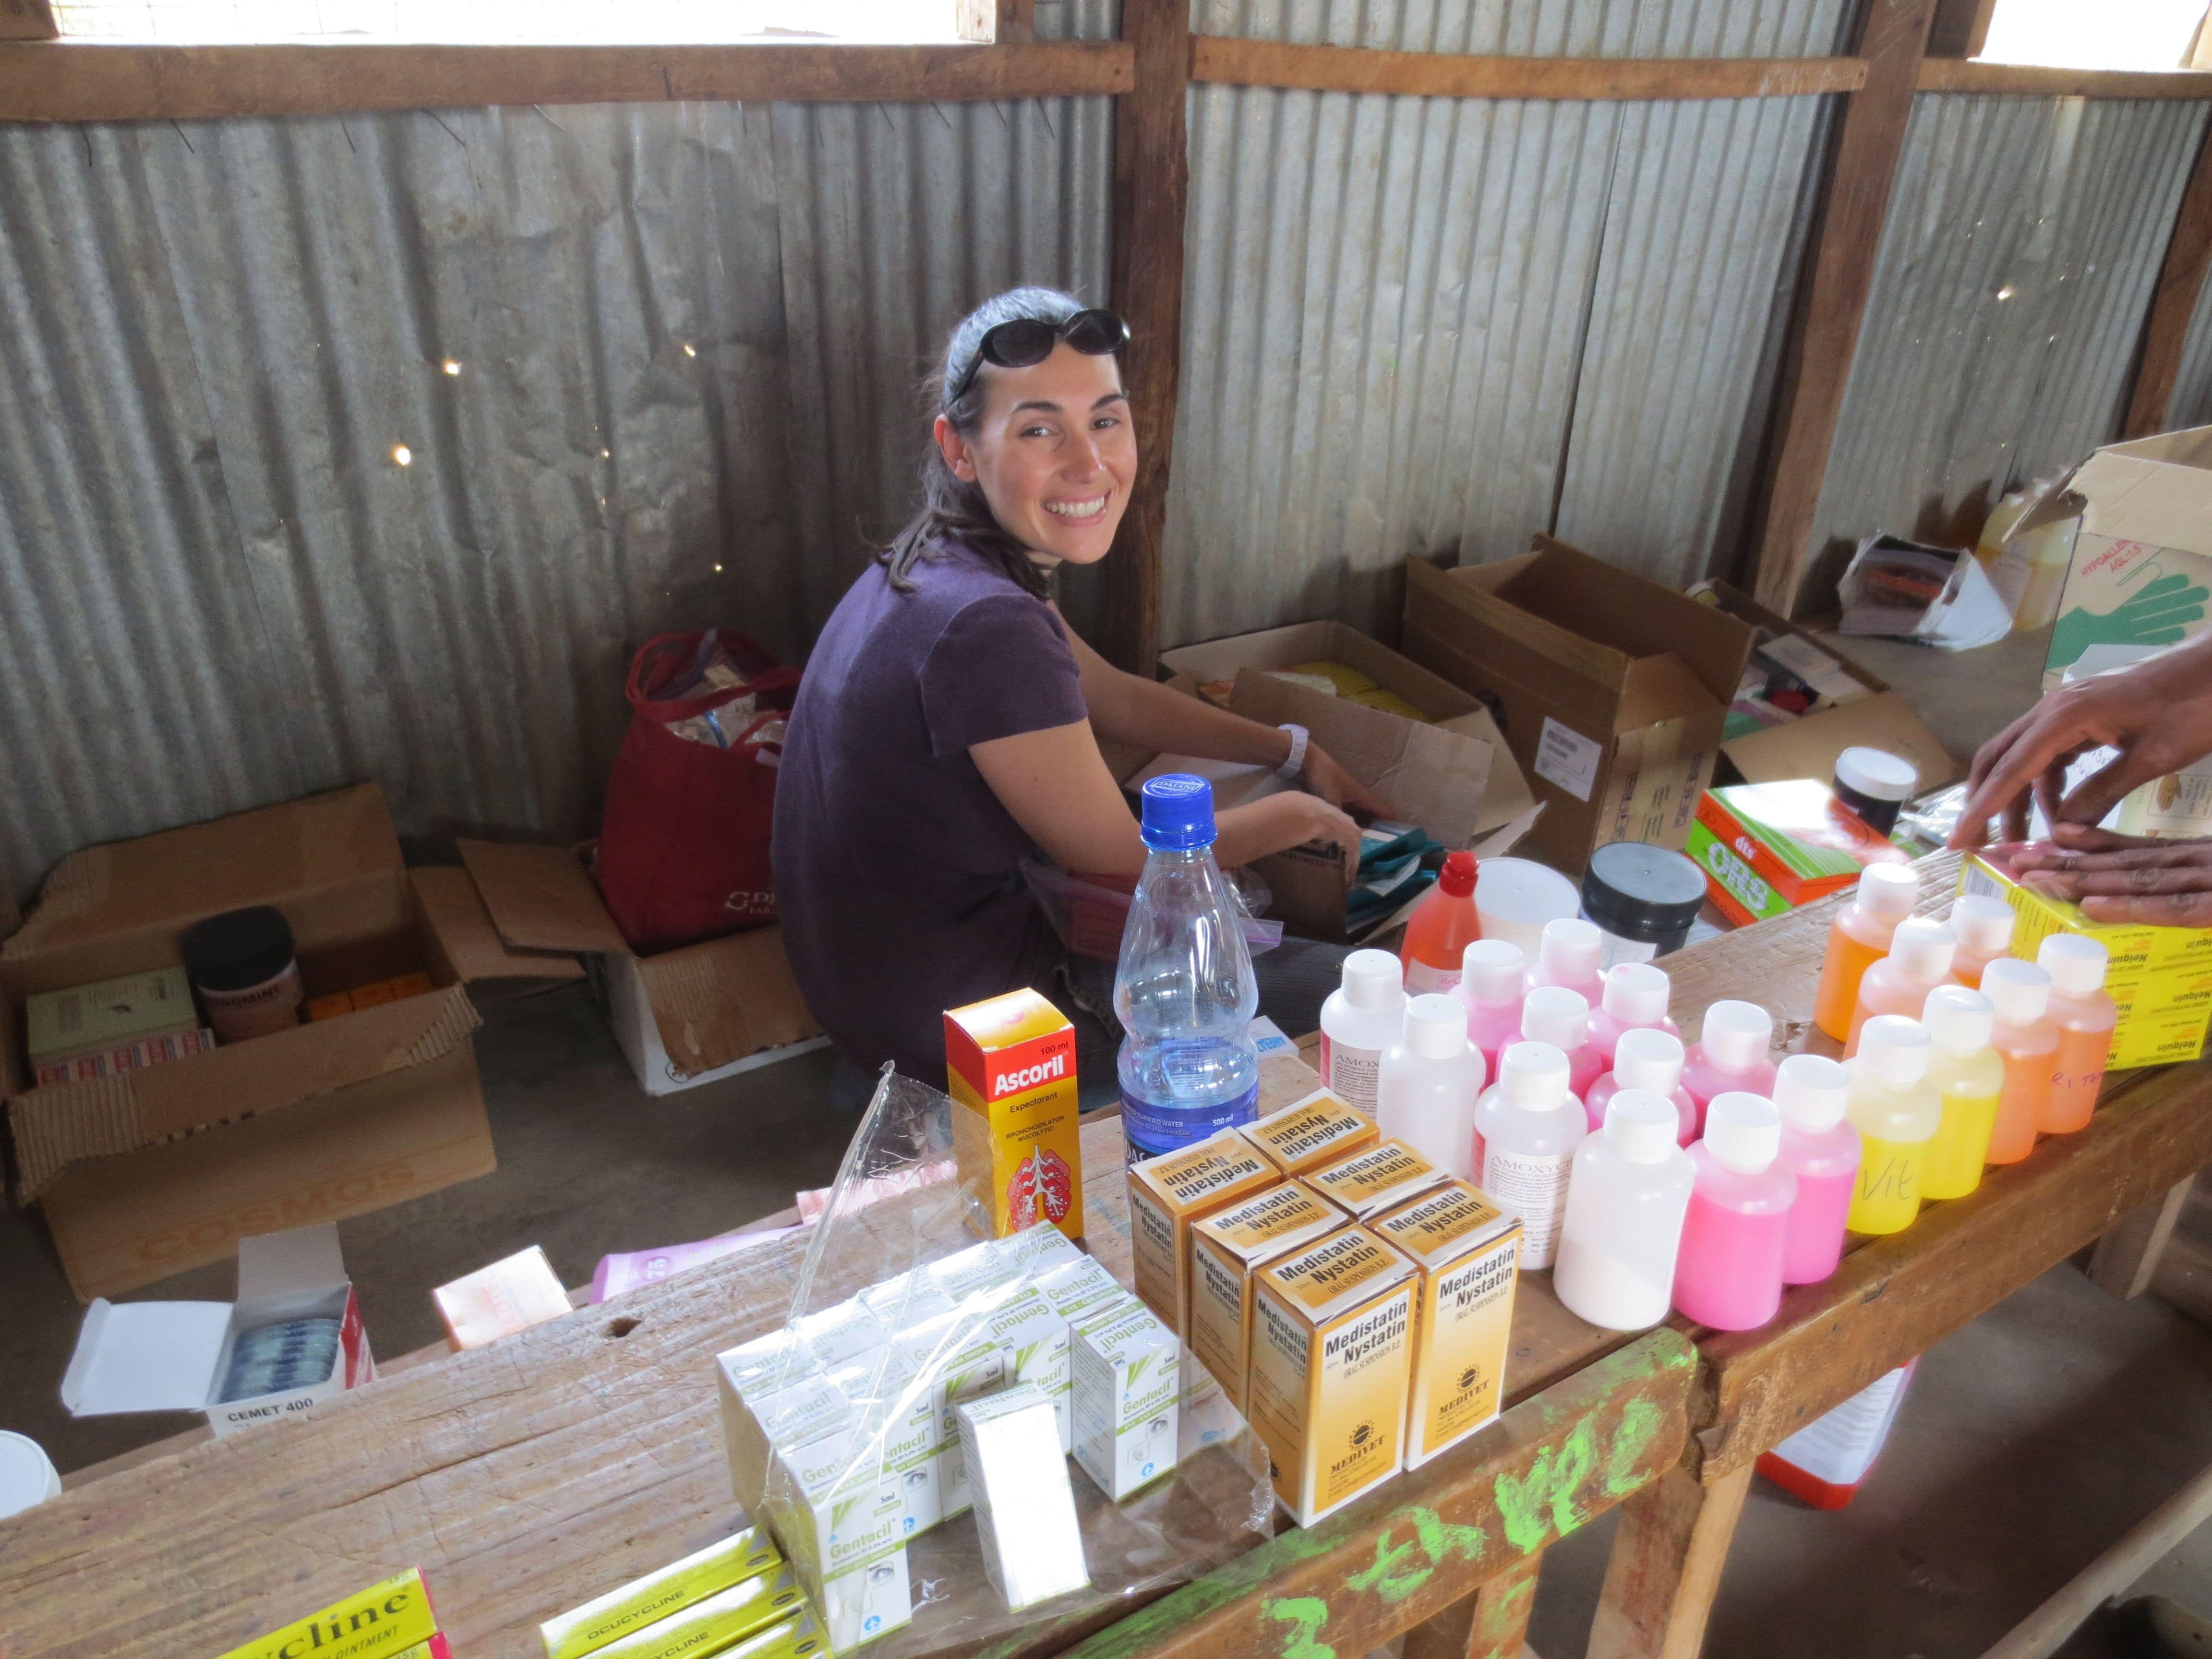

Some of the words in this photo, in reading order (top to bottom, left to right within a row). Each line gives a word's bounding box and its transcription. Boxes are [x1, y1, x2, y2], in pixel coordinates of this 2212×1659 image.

[1708, 842, 1769, 910] ORS
[1041, 1045, 1056, 1055] 100
[1058, 1041, 1069, 1051] ml
[1335, 1054, 1380, 1068] AMOX
[994, 1054, 1064, 1096] Ascoril
[1010, 1092, 1058, 1113] Expectorant
[1006, 1115, 1065, 1139] BRONCHODILATOR
[1018, 1126, 1054, 1142] MUCOLYTIC
[1136, 1112, 1161, 1126] PURIFIED
[1161, 1120, 1184, 1128] WATER
[1213, 1118, 1225, 1127] 500
[1226, 1114, 1234, 1123] ml
[1269, 1114, 1330, 1145] Nystatin
[1272, 1113, 1300, 1129] SUSPENSION
[1281, 1117, 1359, 1154] Medistatin
[1163, 1155, 1230, 1186] Nystatin
[1169, 1153, 1201, 1169] SUSPENSION
[1322, 1148, 1403, 1184] Medistatin
[1352, 1156, 1416, 1185] Nystatin
[1175, 1159, 1260, 1198] Medistatin
[1384, 1171, 1413, 1187] SUSPENSION
[1862, 1156, 1914, 1200] Vit
[137, 1161, 416, 1261] COSMOS
[1133, 1193, 1172, 1238] Medistatin
[1214, 1189, 1300, 1230] Medistatin
[1246, 1200, 1313, 1230] Nystatin
[1278, 1216, 1309, 1233] SUSPENSION
[1387, 1191, 1468, 1233] Medistatin
[1419, 1201, 1484, 1234] Nystatin
[1453, 1216, 1481, 1236] SUSPENSION
[1142, 1214, 1172, 1250] Nystatin
[1196, 1249, 1240, 1297] Medistatin
[1276, 1235, 1365, 1282] Medistatin
[1310, 1245, 1380, 1284] Nystatin
[1345, 1264, 1377, 1286] SUSPENSION
[1440, 1249, 1515, 1299] Medistatin
[1047, 1270, 1103, 1299] Gentacil
[1205, 1270, 1239, 1310] Nystatin
[1456, 1266, 1513, 1308] Nystatin
[1469, 1290, 1499, 1313] SUSPENSION
[991, 1304, 1050, 1337] Gentacil
[1100, 1318, 1157, 1351] Gentacil
[1258, 1298, 1307, 1351] Medistatin
[1325, 1301, 1407, 1357] Medistatin
[964, 1346, 989, 1360] DROPS
[1055, 1340, 1066, 1351] 5ml
[1268, 1321, 1306, 1364] Nystatin
[1344, 1320, 1405, 1364] Nystatin
[1357, 1344, 1391, 1370] SUSPENSION
[986, 1367, 998, 1379] 5ml
[1164, 1353, 1176, 1365] 5ml
[1037, 1365, 1062, 1387] tacil
[227, 1404, 281, 1422] CEMET
[286, 1397, 314, 1411] 400
[916, 1402, 929, 1415] 5ml
[1123, 1379, 1170, 1414] Gentacil
[1440, 1379, 1490, 1413] MEDIVET
[887, 1429, 926, 1457] ntacil
[1331, 1434, 1385, 1472] MEDIVET
[880, 1491, 895, 1505] 5ml
[830, 1521, 891, 1559] Gentacil
[587, 1589, 685, 1640] OCUCYCLINE
[336, 1624, 398, 1659] OINTMENT
